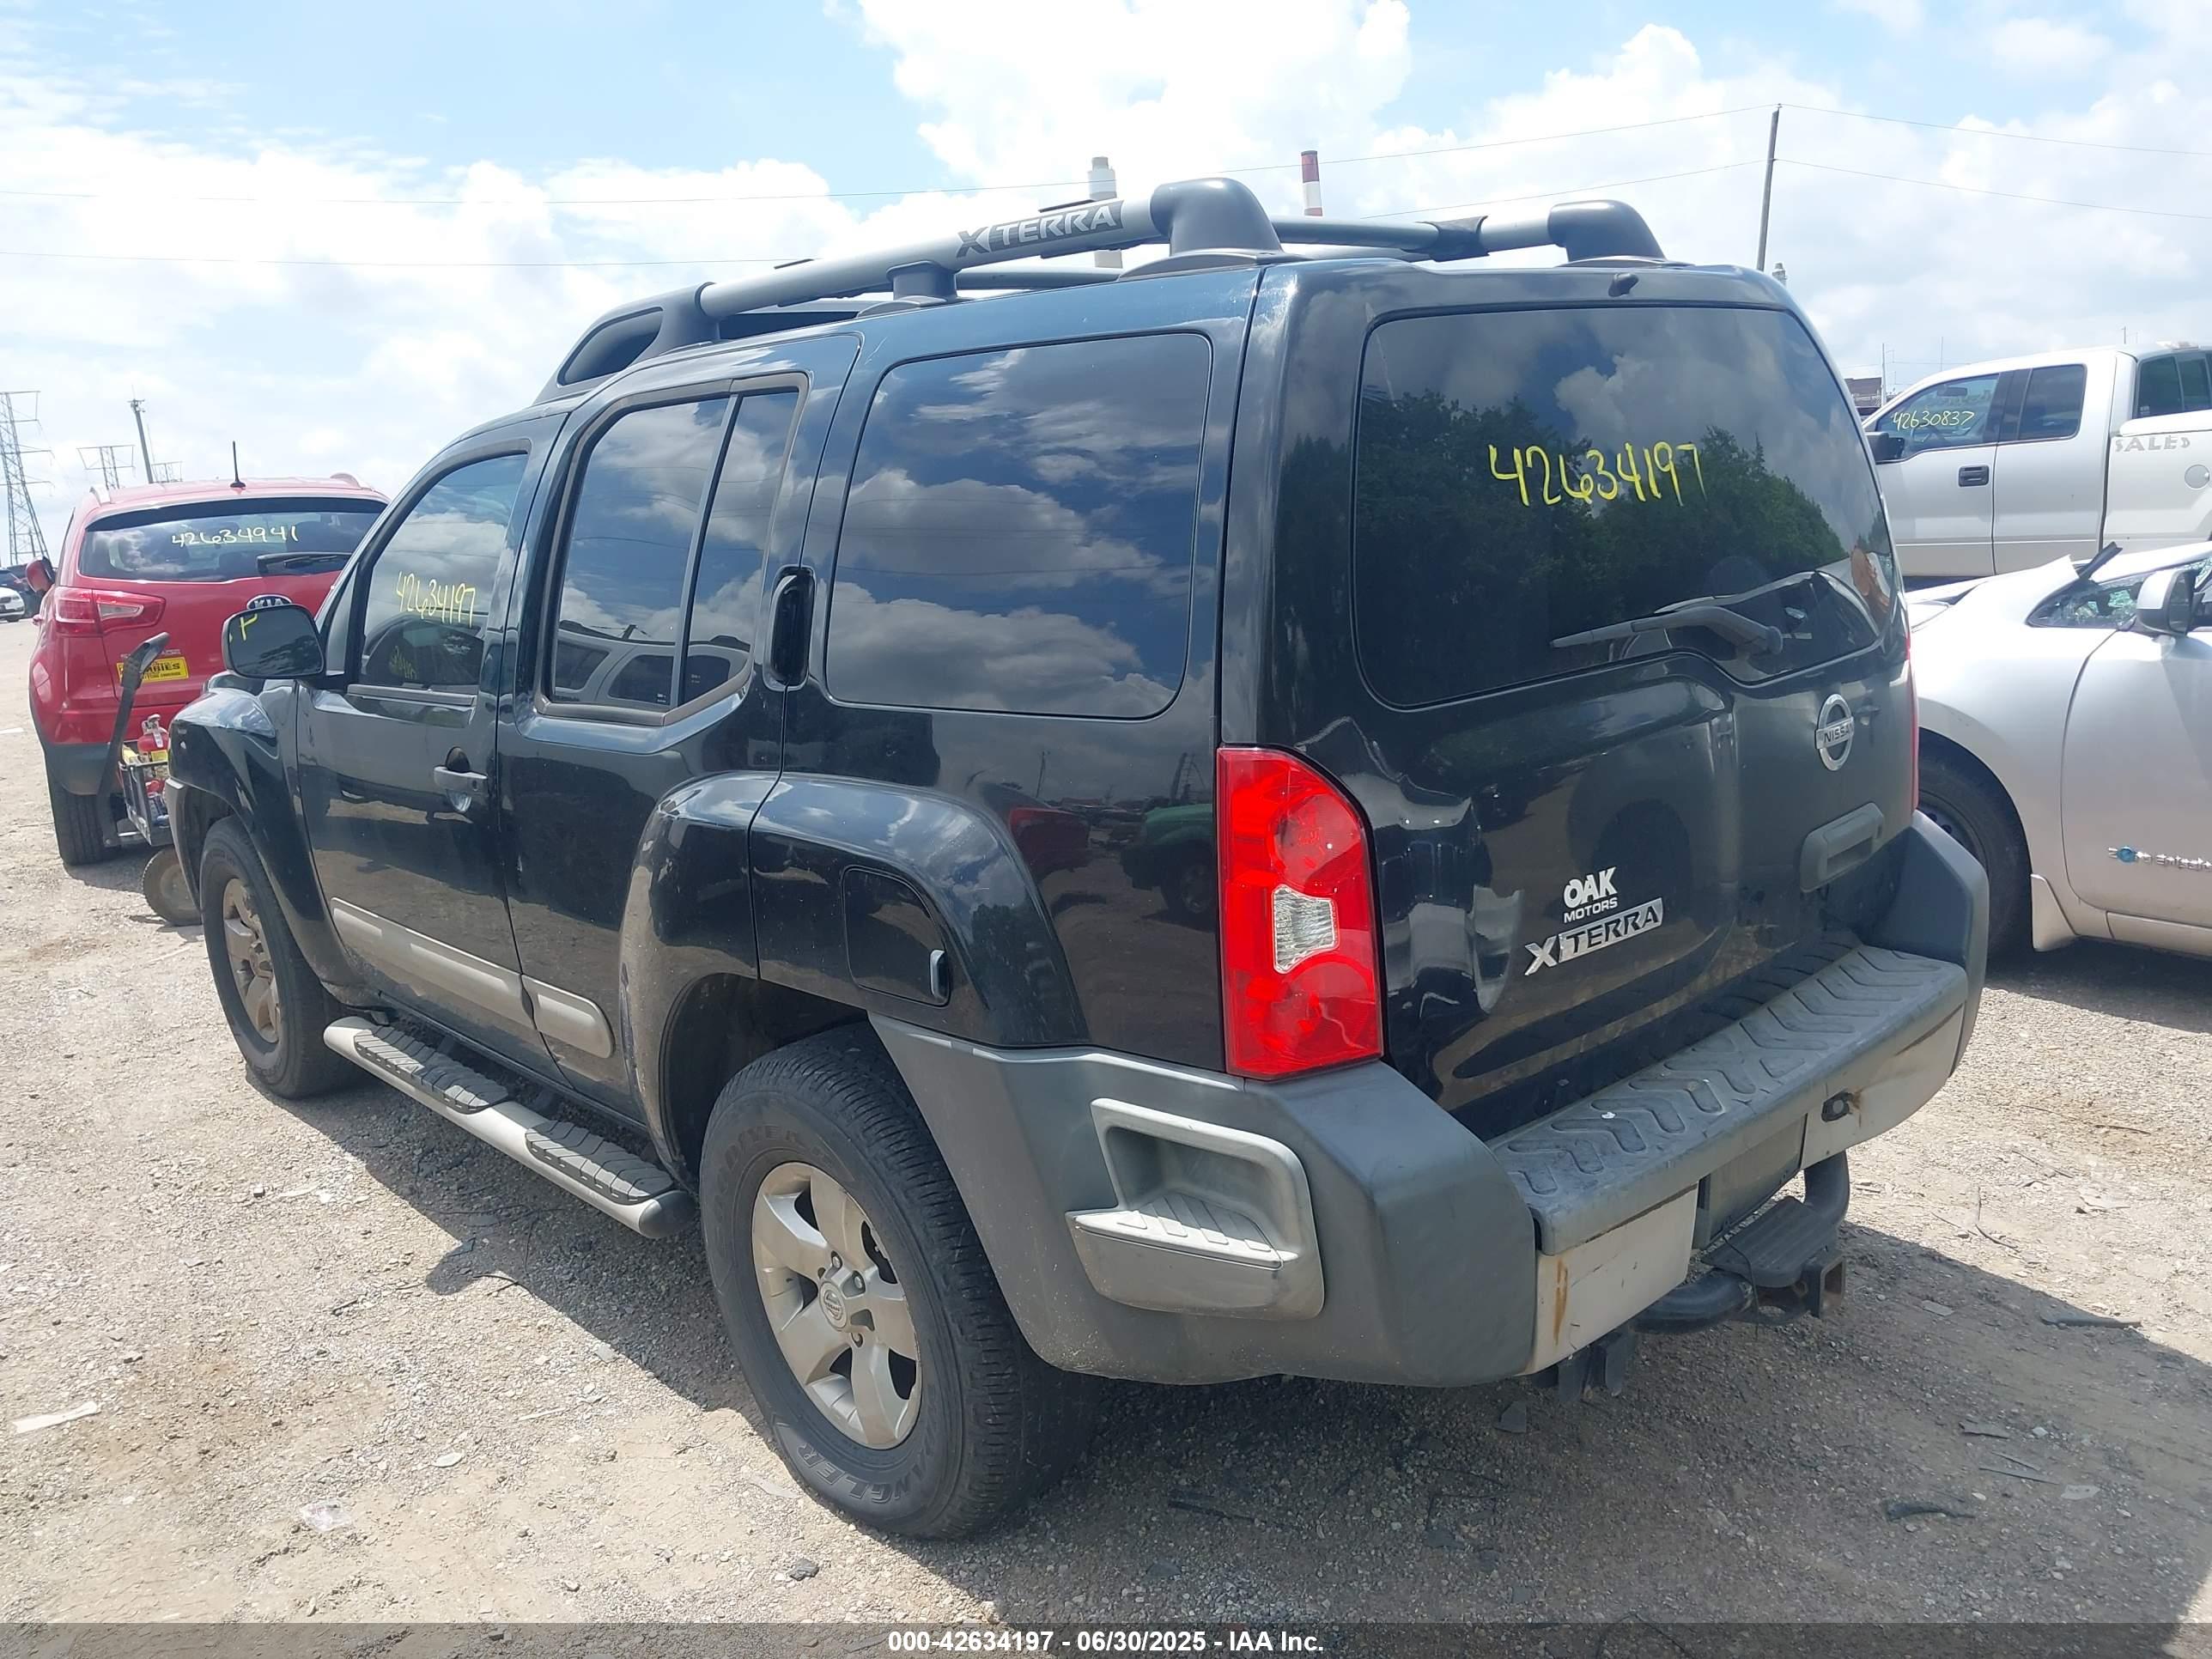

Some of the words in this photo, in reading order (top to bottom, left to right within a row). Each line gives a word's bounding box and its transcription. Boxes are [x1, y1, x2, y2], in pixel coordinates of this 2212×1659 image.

[956, 204, 1120, 258] XTERRA
[1893, 410, 1975, 431] 42630837
[1488, 441, 1707, 507] 42634197
[172, 526, 299, 548] 42634941
[396, 570, 476, 629] 42634197
[1564, 866, 1618, 908] OAK
[1564, 896, 1619, 923] MOTORS
[1524, 897, 1663, 975] XTERRA
